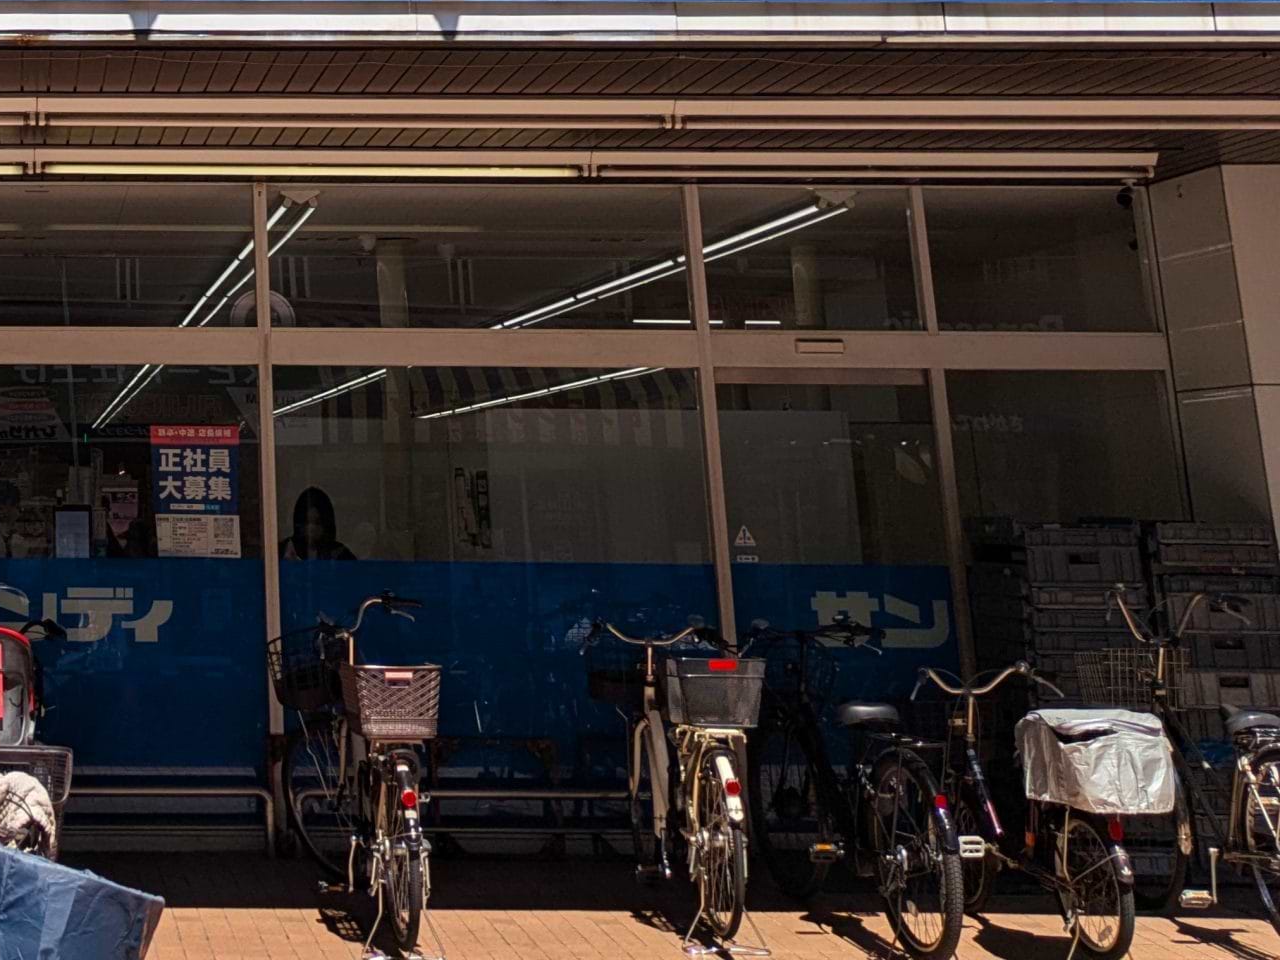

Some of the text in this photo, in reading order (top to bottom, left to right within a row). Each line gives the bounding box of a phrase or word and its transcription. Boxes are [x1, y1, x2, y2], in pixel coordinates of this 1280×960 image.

[159, 448, 231, 473] 正社員
[159, 475, 232, 501] 大募集
